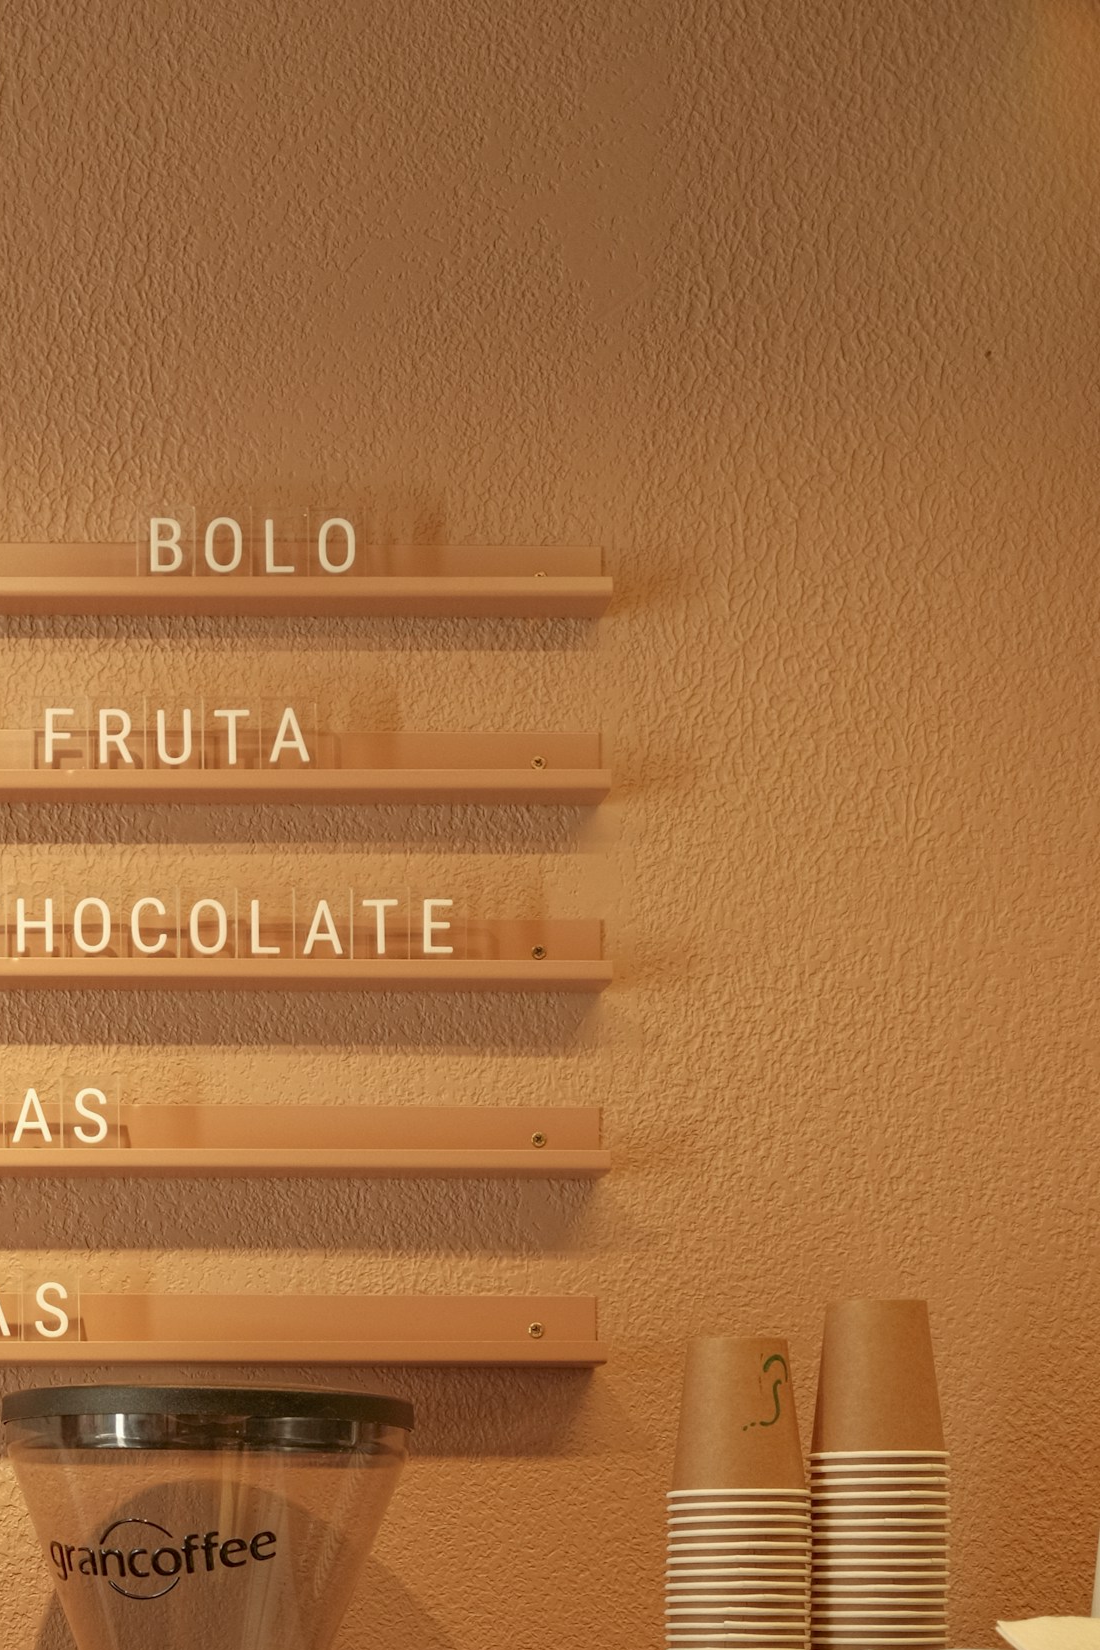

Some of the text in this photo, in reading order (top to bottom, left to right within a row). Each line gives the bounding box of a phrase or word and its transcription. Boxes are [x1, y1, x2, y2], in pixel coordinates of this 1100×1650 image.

[149, 516, 356, 573] BOLO
[44, 707, 310, 765] FRUTA
[50, 1530, 277, 1581] grancoffee
